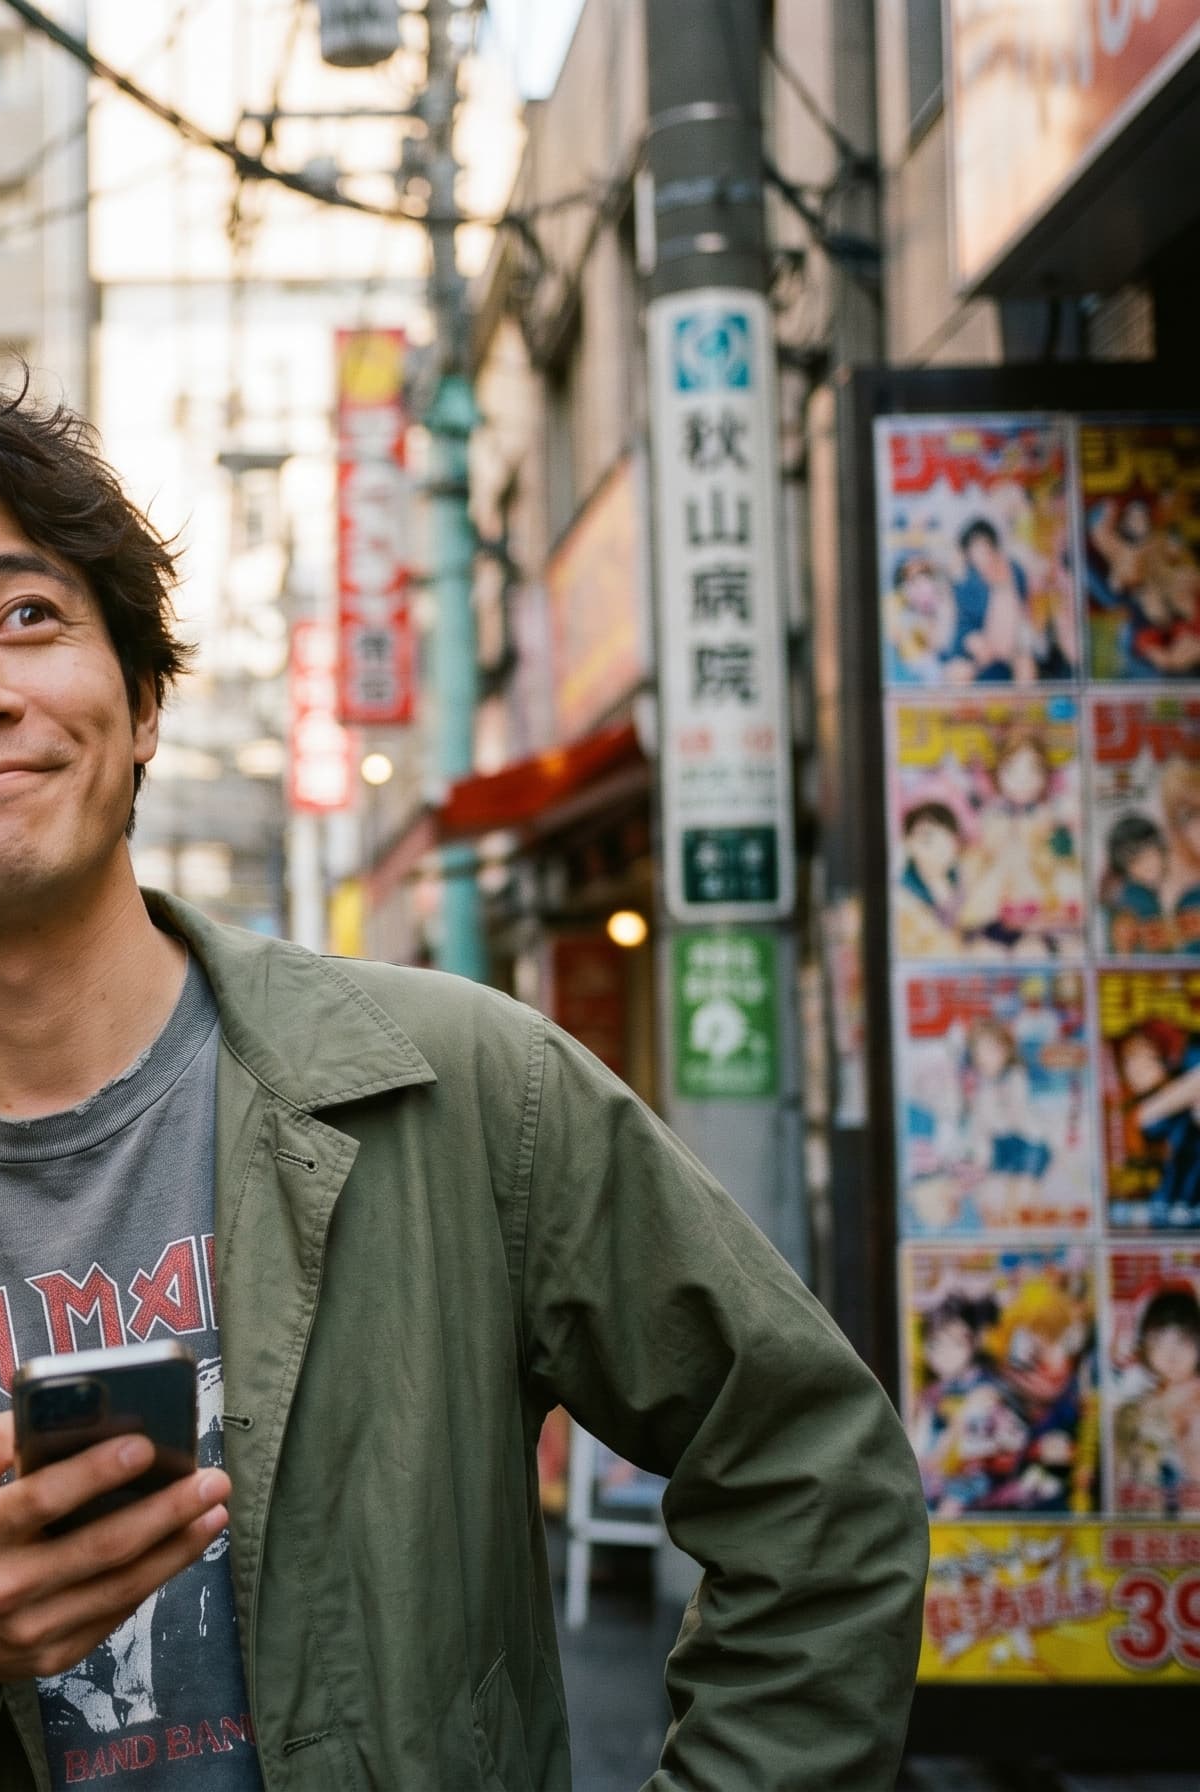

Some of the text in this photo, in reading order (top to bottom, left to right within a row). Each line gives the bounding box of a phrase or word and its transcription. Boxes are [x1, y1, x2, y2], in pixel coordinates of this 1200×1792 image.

[681, 406, 762, 704] 秋山病院
[64, 1734, 158, 1784] BAND
